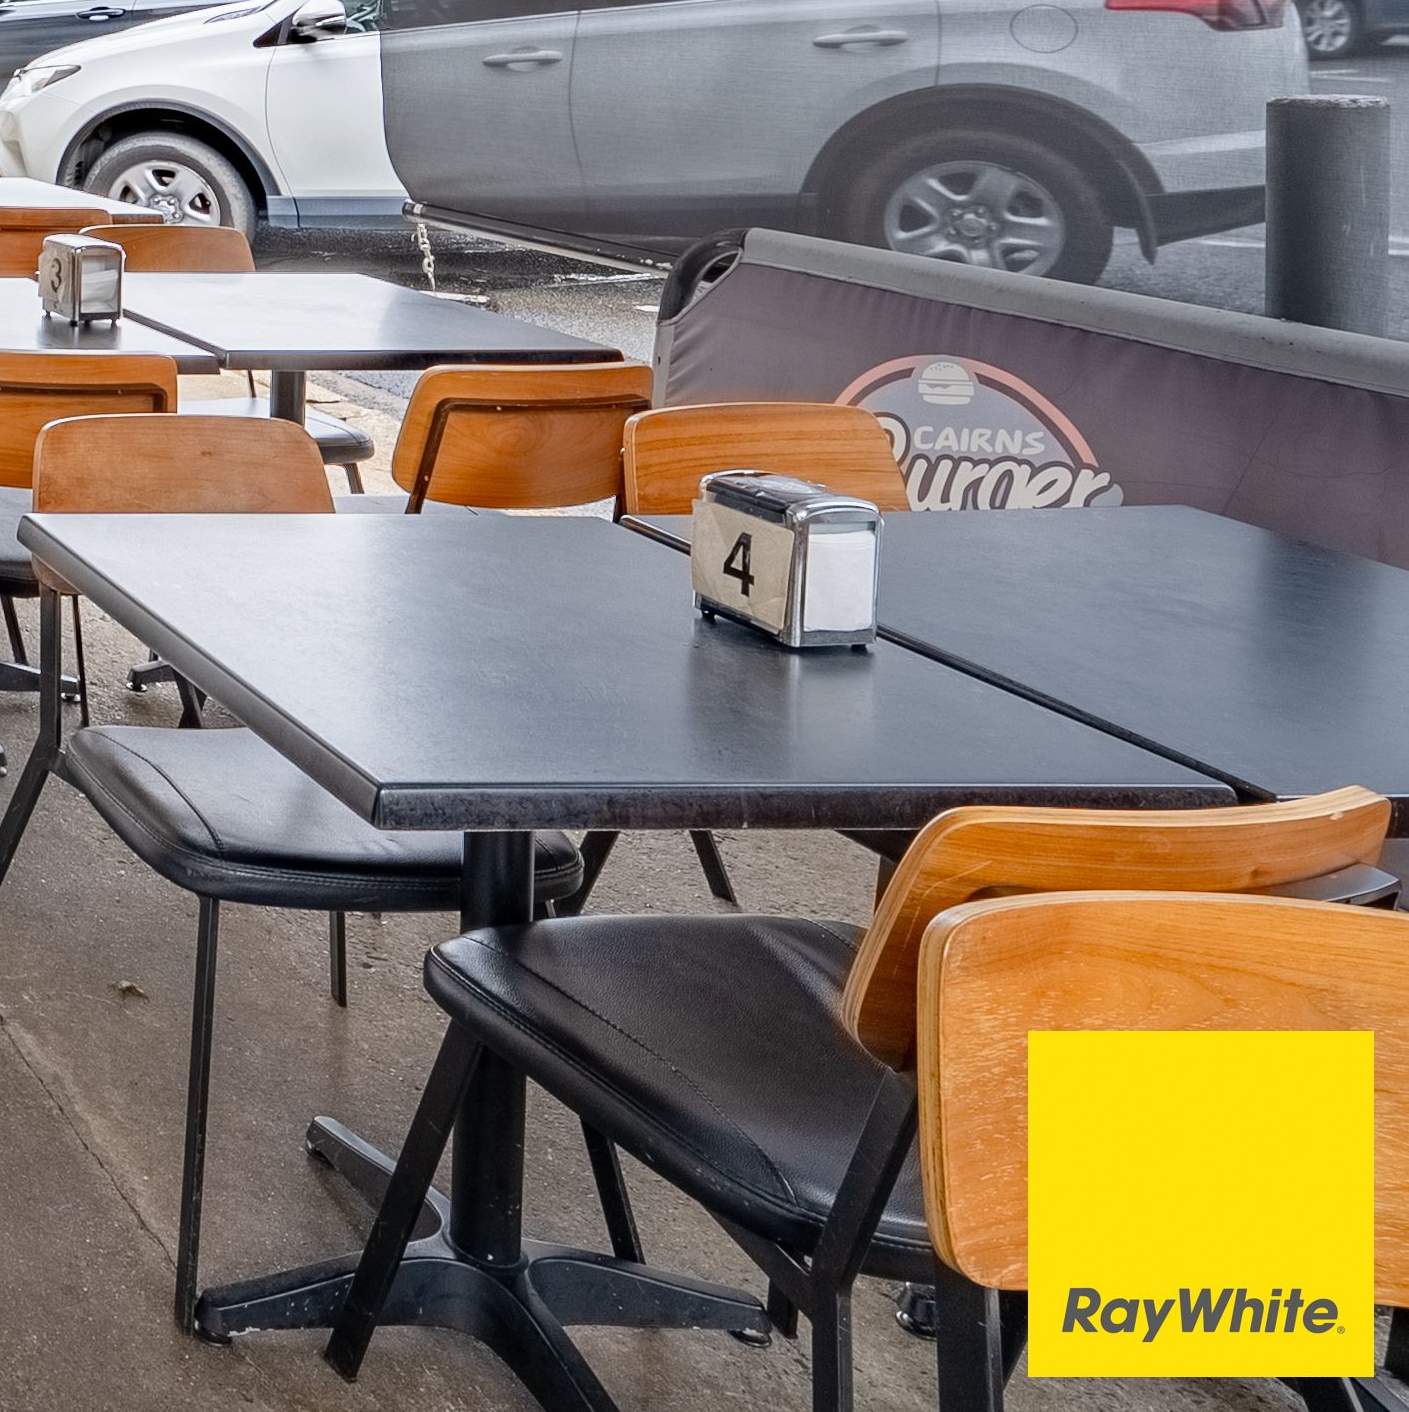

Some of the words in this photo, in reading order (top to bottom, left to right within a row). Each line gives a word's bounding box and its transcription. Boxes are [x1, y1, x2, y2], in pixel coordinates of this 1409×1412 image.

[50, 258, 63, 293] 3
[913, 426, 1046, 456] CAIRNS
[722, 532, 755, 598] 4
